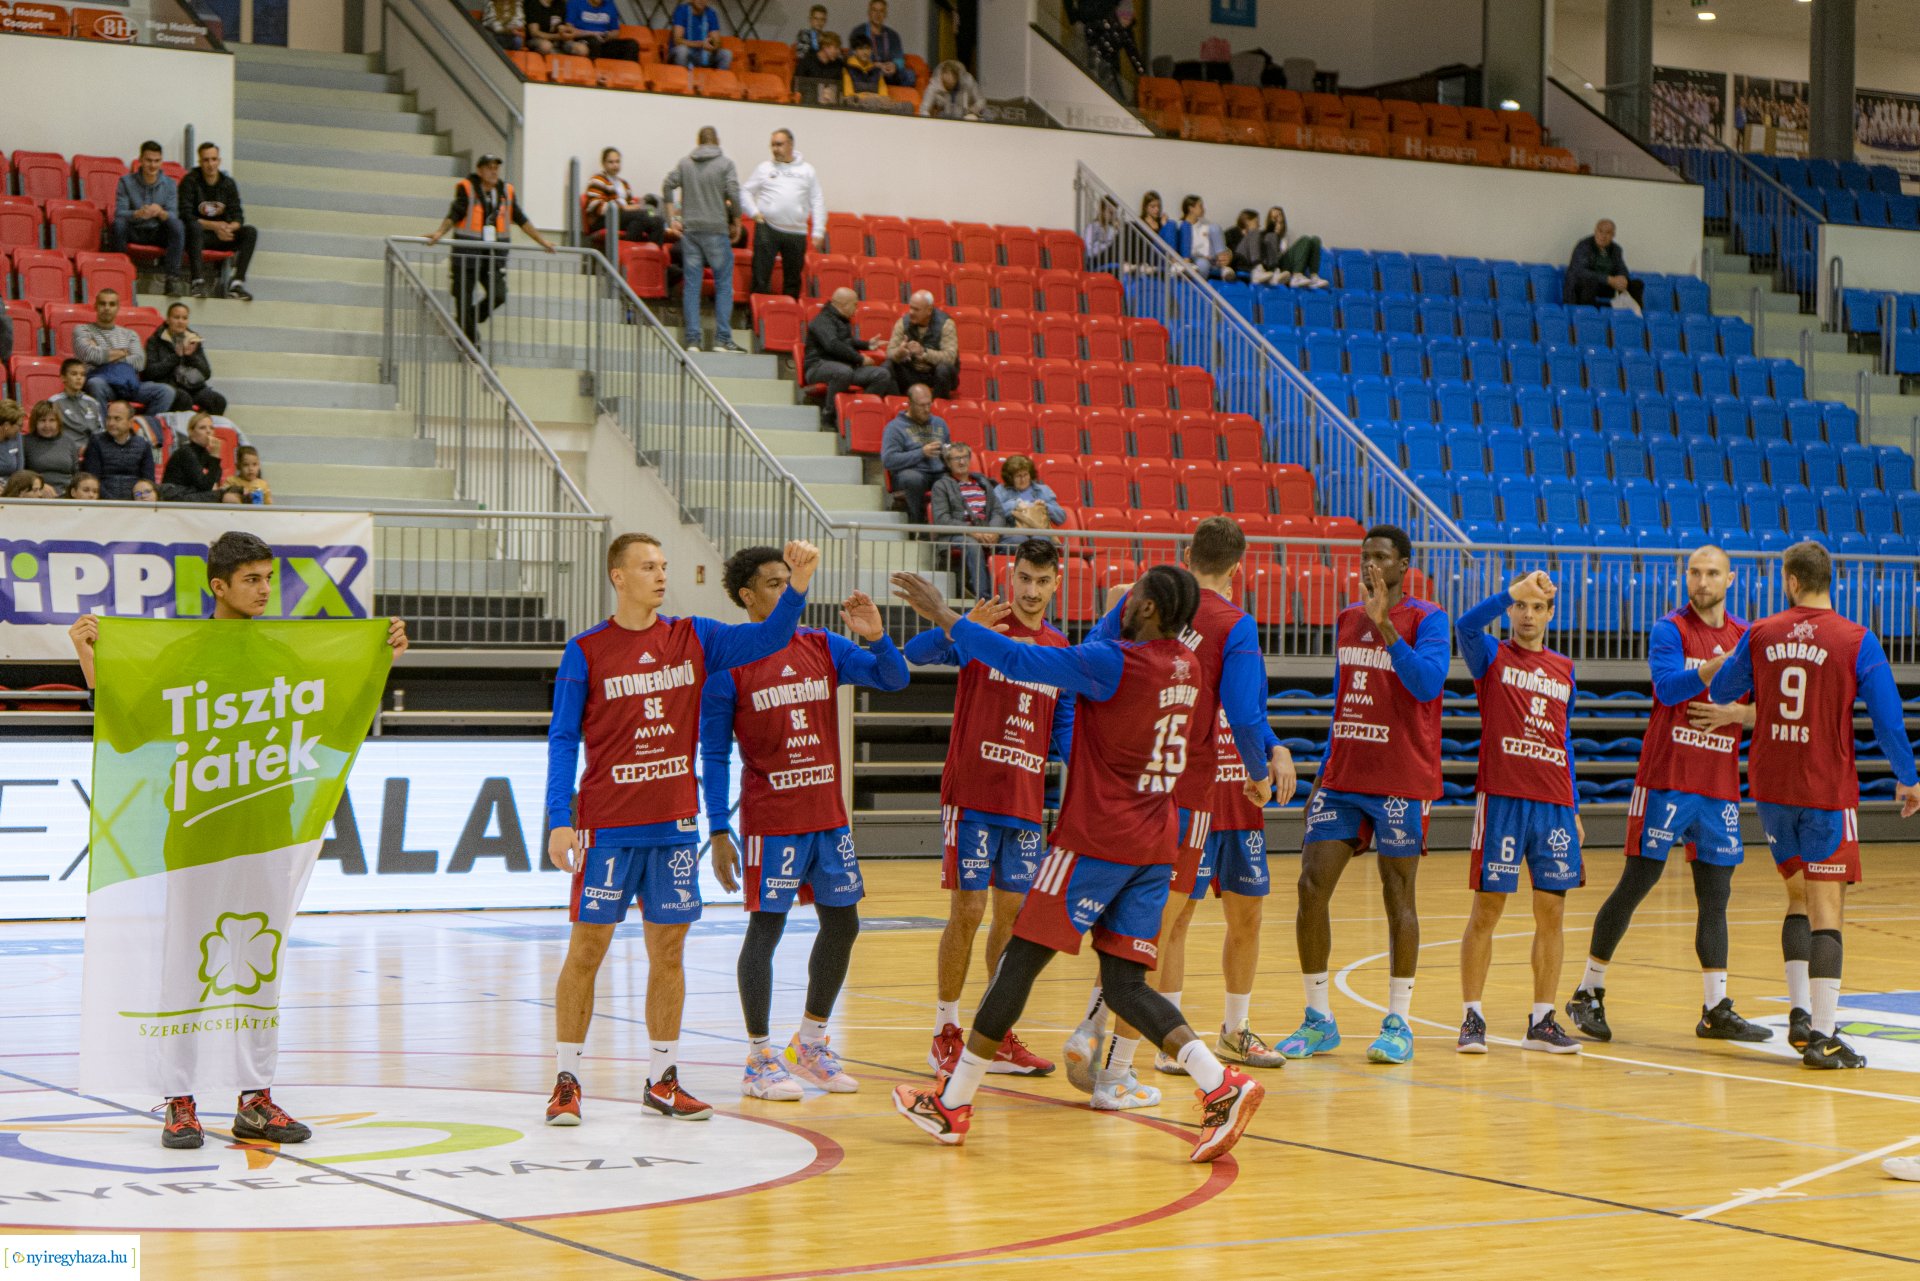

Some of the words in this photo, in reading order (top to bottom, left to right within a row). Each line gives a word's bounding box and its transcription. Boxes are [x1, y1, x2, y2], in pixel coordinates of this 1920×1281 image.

[103, 19, 131, 37] BH
[0, 552, 358, 618] iPPMIX
[1339, 646, 1395, 673] TOMERŐM
[1765, 642, 1828, 666] GRUBOR
[604, 660, 695, 700] ATOMERŐMŰ
[1353, 671, 1368, 690] SE
[1019, 692, 1032, 714] SE
[1344, 693, 1374, 706] MVM
[1779, 666, 1807, 720] 9
[162, 676, 325, 736] Tiszta
[644, 697, 664, 720] SE
[1530, 697, 1548, 717] SE
[790, 709, 808, 730] SE
[1006, 714, 1034, 732] MVM
[1220, 708, 1231, 729] S
[1524, 714, 1554, 732] MVM
[634, 723, 675, 739] MVM
[786, 733, 820, 749] MVM
[1771, 723, 1810, 744] PAKS
[1145, 713, 1188, 774] 15
[173, 720, 322, 812] játék
[1312, 791, 1326, 813] 5
[316, 777, 578, 876] ALA
[1307, 810, 1338, 825] PPMIX
[1664, 803, 1677, 829] 7
[976, 830, 989, 858] 3
[1501, 836, 1515, 862] 6
[603, 857, 615, 887] 1
[781, 846, 796, 876] 2
[1488, 862, 1520, 874] TiPPMI
[1011, 872, 1036, 881] MERCA
[1077, 897, 1105, 914] MV
[0, 1154, 703, 1205] NYÍREGYHÁZA
